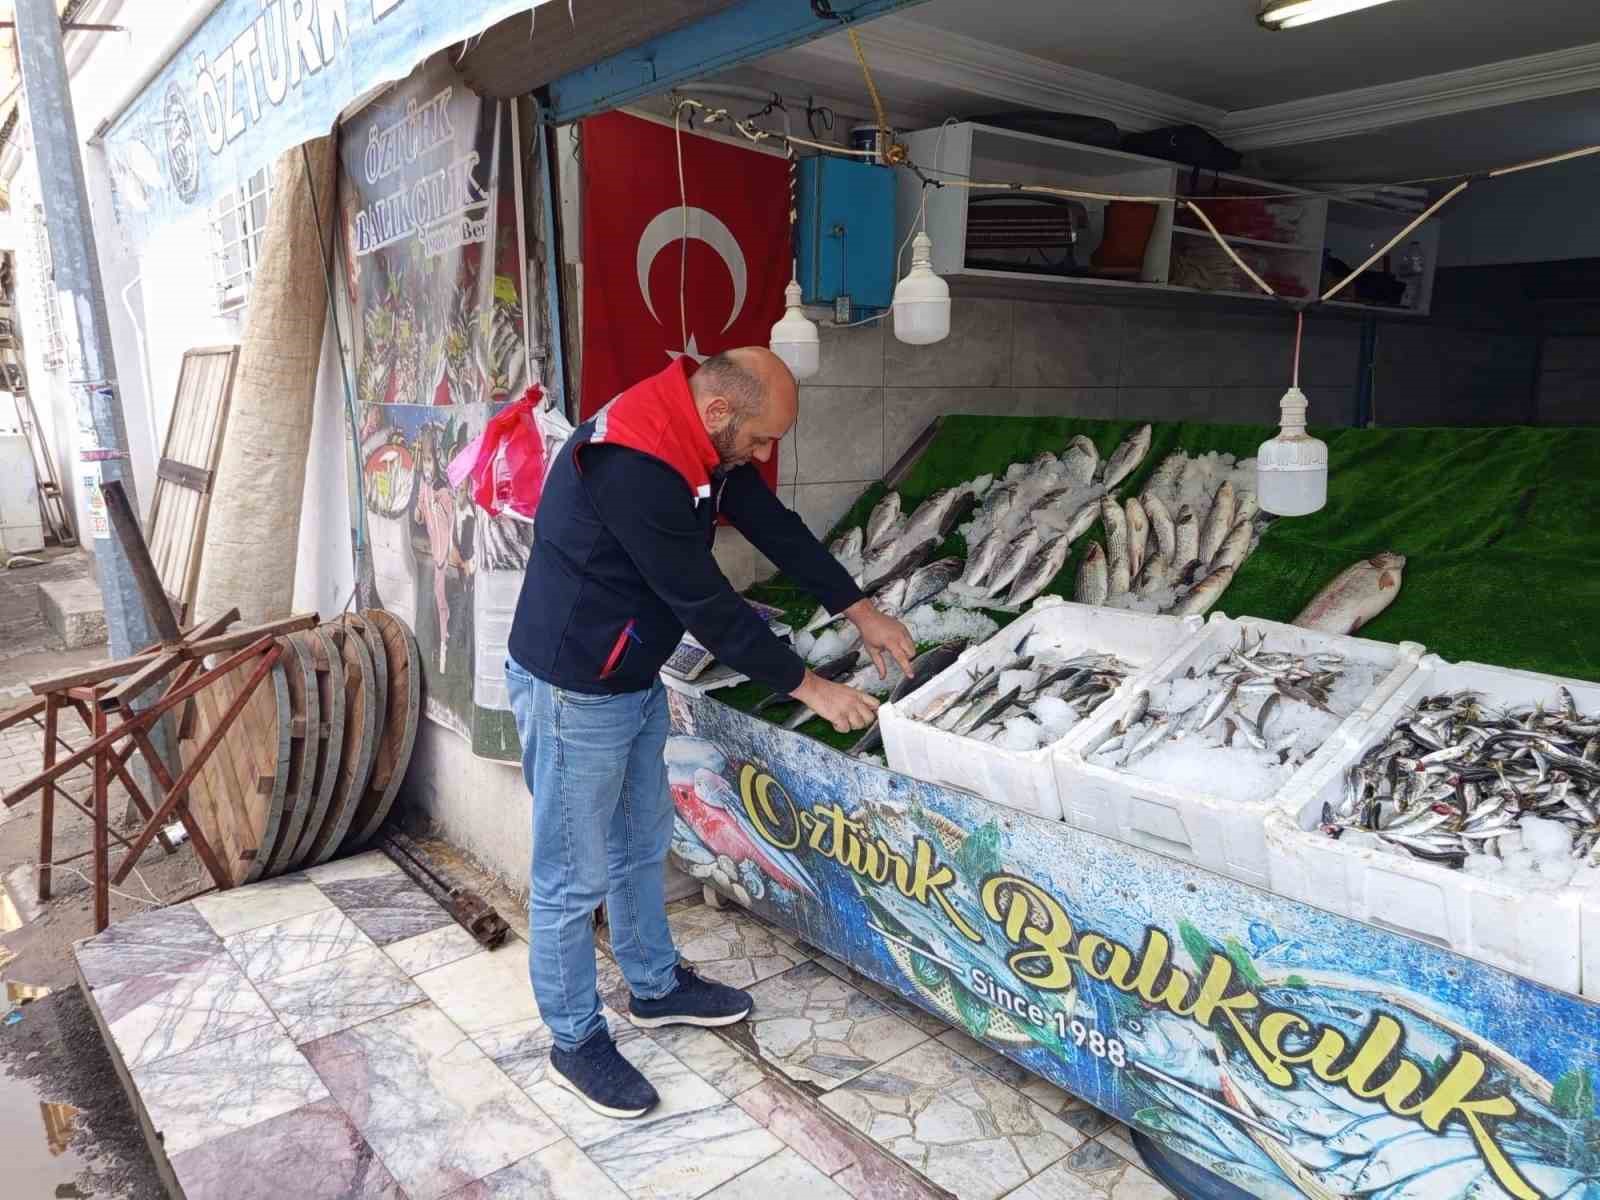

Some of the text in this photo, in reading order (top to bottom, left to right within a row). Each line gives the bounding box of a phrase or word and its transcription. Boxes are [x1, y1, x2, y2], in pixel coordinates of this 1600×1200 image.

[355, 151, 490, 256] BALIKÇILIK
[971, 968, 1127, 1069] Since 1988
